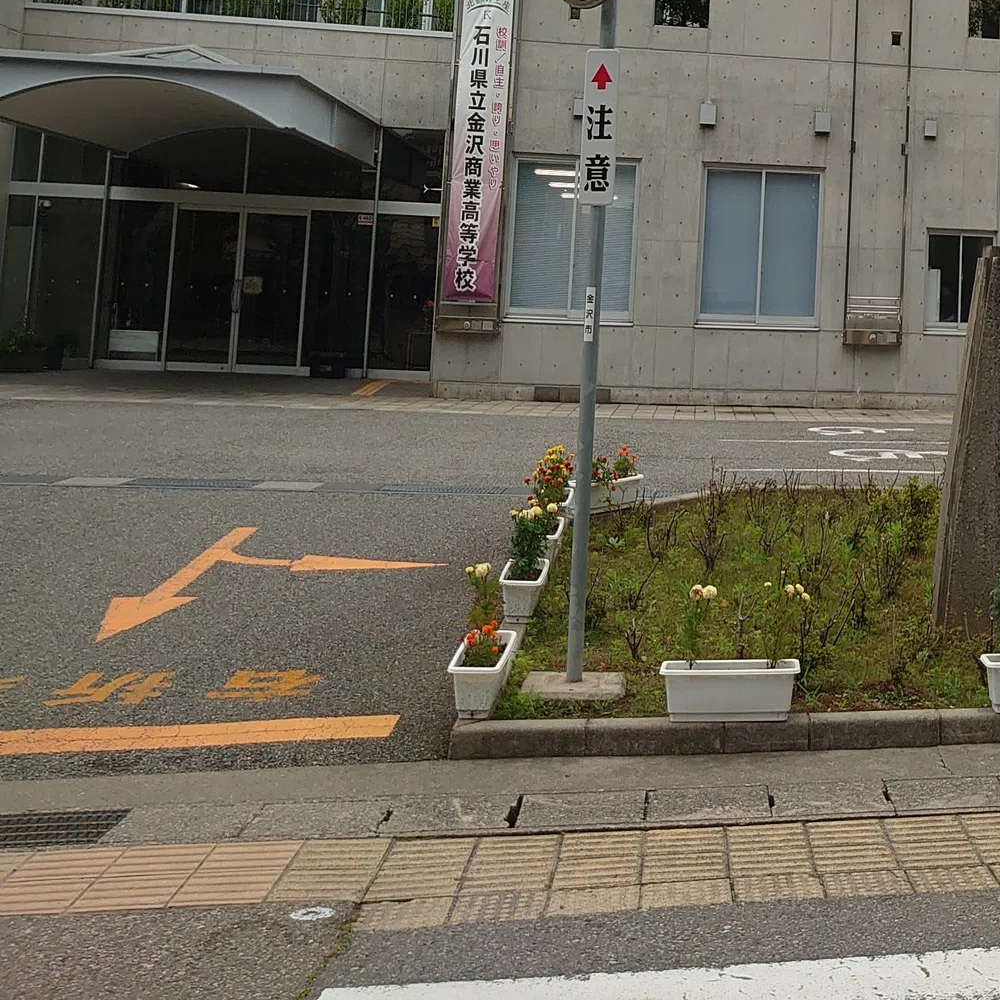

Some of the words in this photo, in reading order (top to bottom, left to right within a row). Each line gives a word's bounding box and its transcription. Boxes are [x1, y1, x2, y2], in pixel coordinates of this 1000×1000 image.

[454, 25, 491, 291] 石川県立金沢商業高等学校
[584, 104, 613, 192] 注意
[585, 293, 594, 334] 金沢市
[0, 669, 325, 706] 右折
